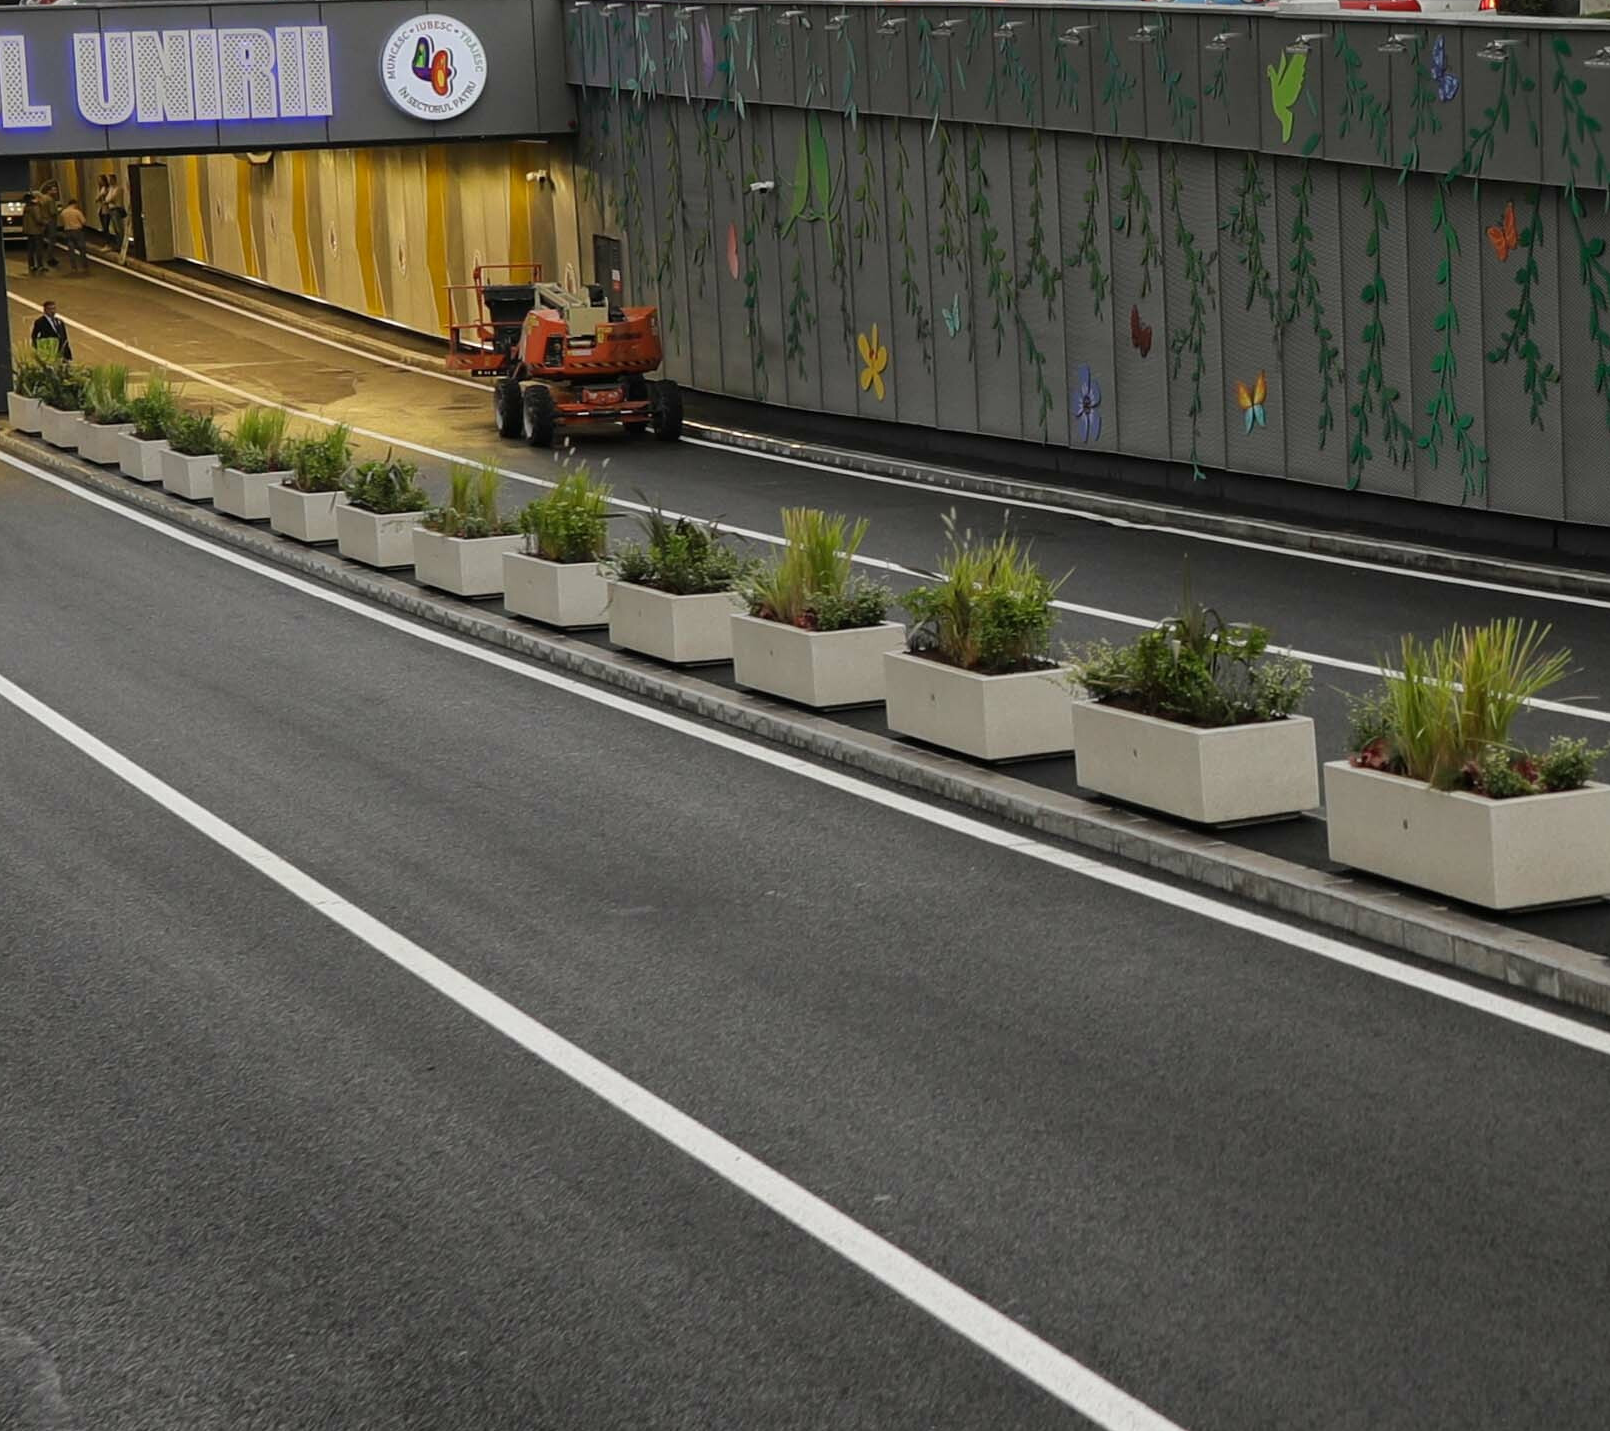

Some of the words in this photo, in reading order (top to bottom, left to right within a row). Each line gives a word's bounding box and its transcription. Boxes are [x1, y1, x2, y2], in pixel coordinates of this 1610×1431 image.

[72, 24, 334, 126] UNIRII
[385, 30, 412, 80] MUNCESC
[415, 20, 454, 32] IUBESC
[407, 97, 454, 114] SECTORUL
[453, 81, 477, 108] PATRU
